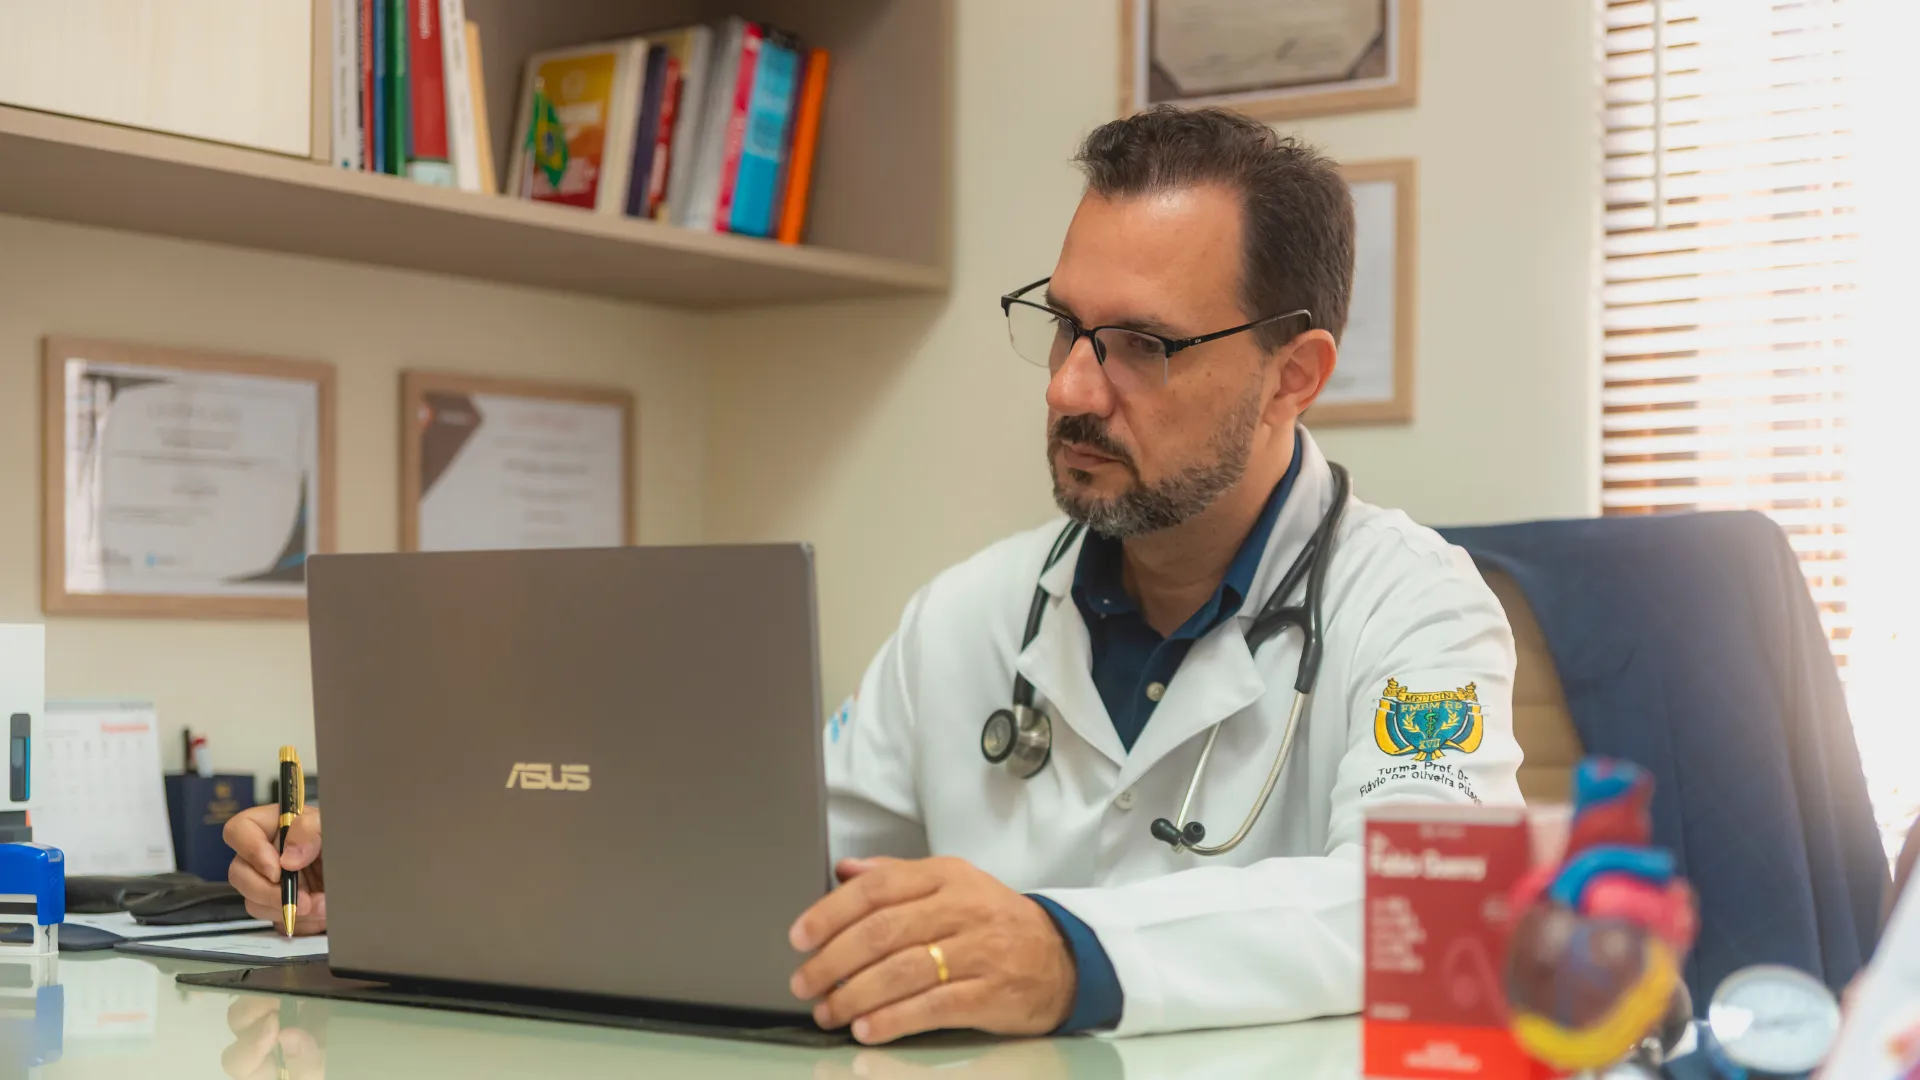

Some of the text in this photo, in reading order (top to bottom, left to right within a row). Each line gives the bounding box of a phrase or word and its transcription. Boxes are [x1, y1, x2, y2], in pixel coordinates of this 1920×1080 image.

[505, 762, 591, 792] ASUS
[1377, 761, 1472, 786] Turma Prof. Dr.
[1411, 770, 1455, 788] Oliveira
